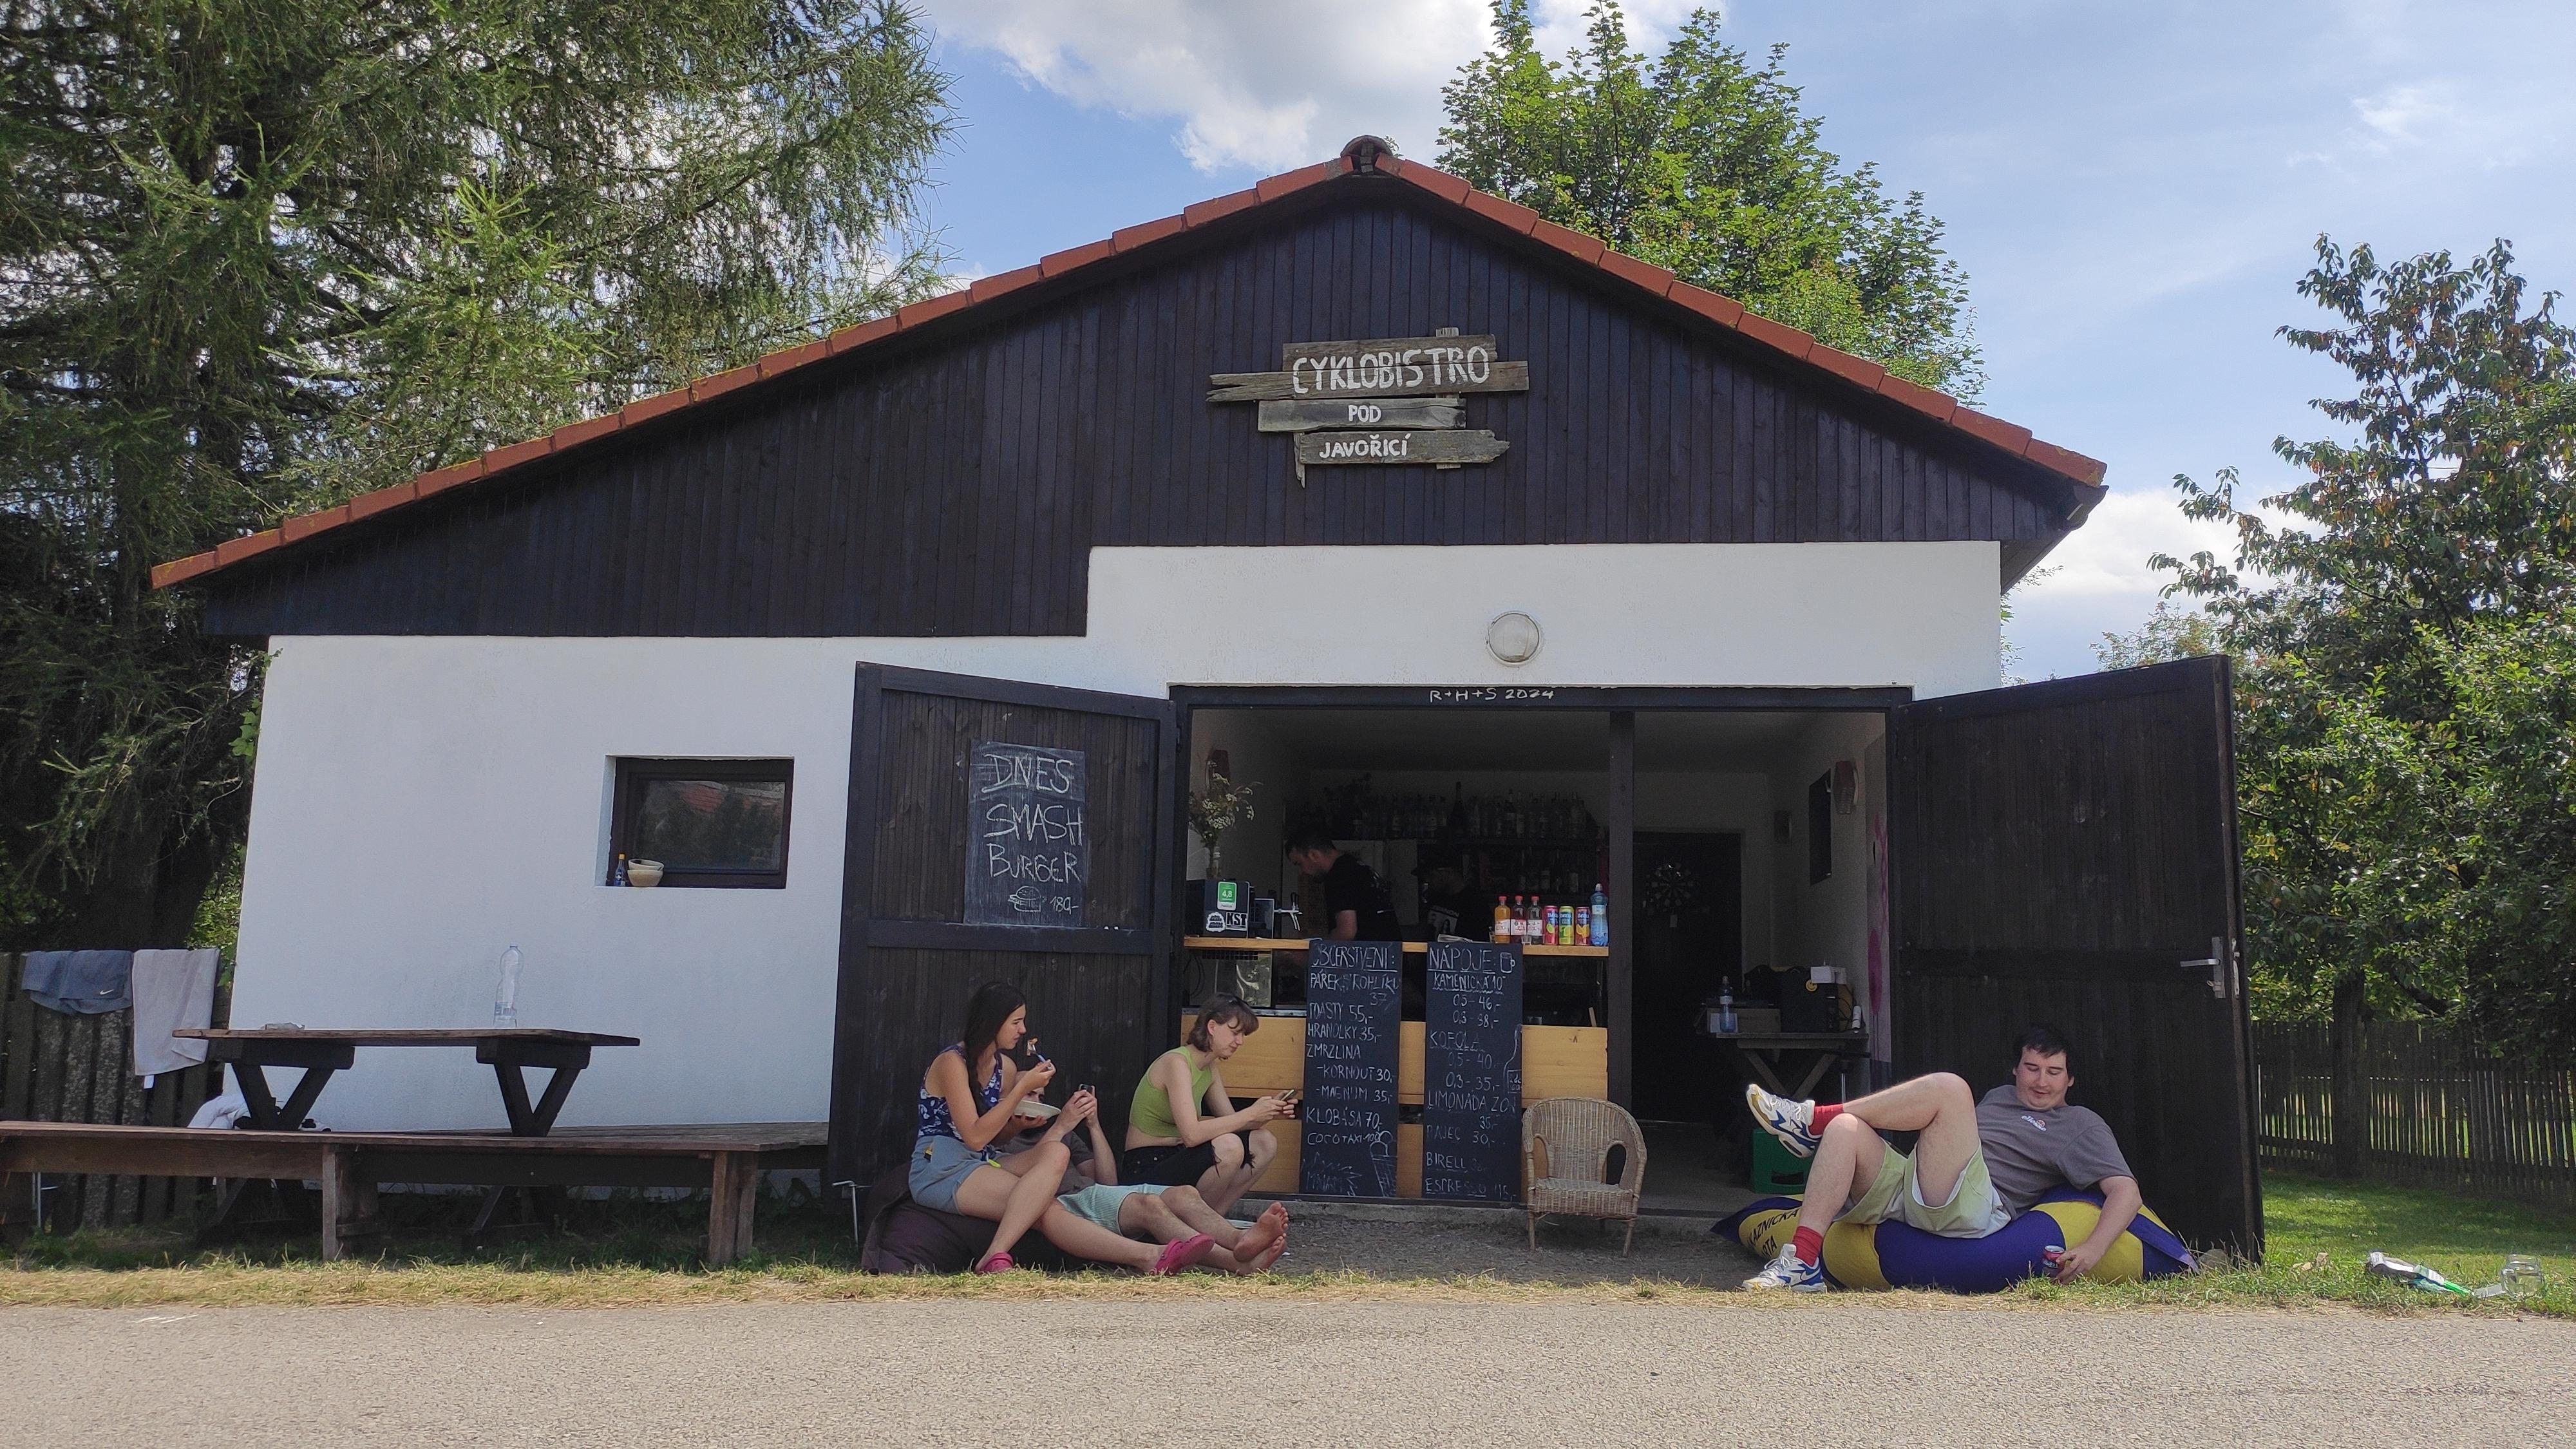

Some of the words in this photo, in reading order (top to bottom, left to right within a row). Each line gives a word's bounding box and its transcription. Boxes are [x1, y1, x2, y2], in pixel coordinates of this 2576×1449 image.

[1293, 346, 1490, 393] CYKLOBISTRO
[1348, 404, 1381, 423] POD
[1319, 433, 1412, 459] JAVOŘICÍ
[1505, 689, 1555, 699] 2024
[981, 753, 1074, 793] DNES
[983, 804, 1083, 846] SMASH
[987, 843, 1081, 883] BURGER
[1310, 1002, 1343, 1019] TOASTY
[1308, 1023, 1357, 1039] HRANOLKY
[1306, 1044, 1361, 1059] ZMRZLINA
[1426, 1151, 1466, 1169] BIRELL
